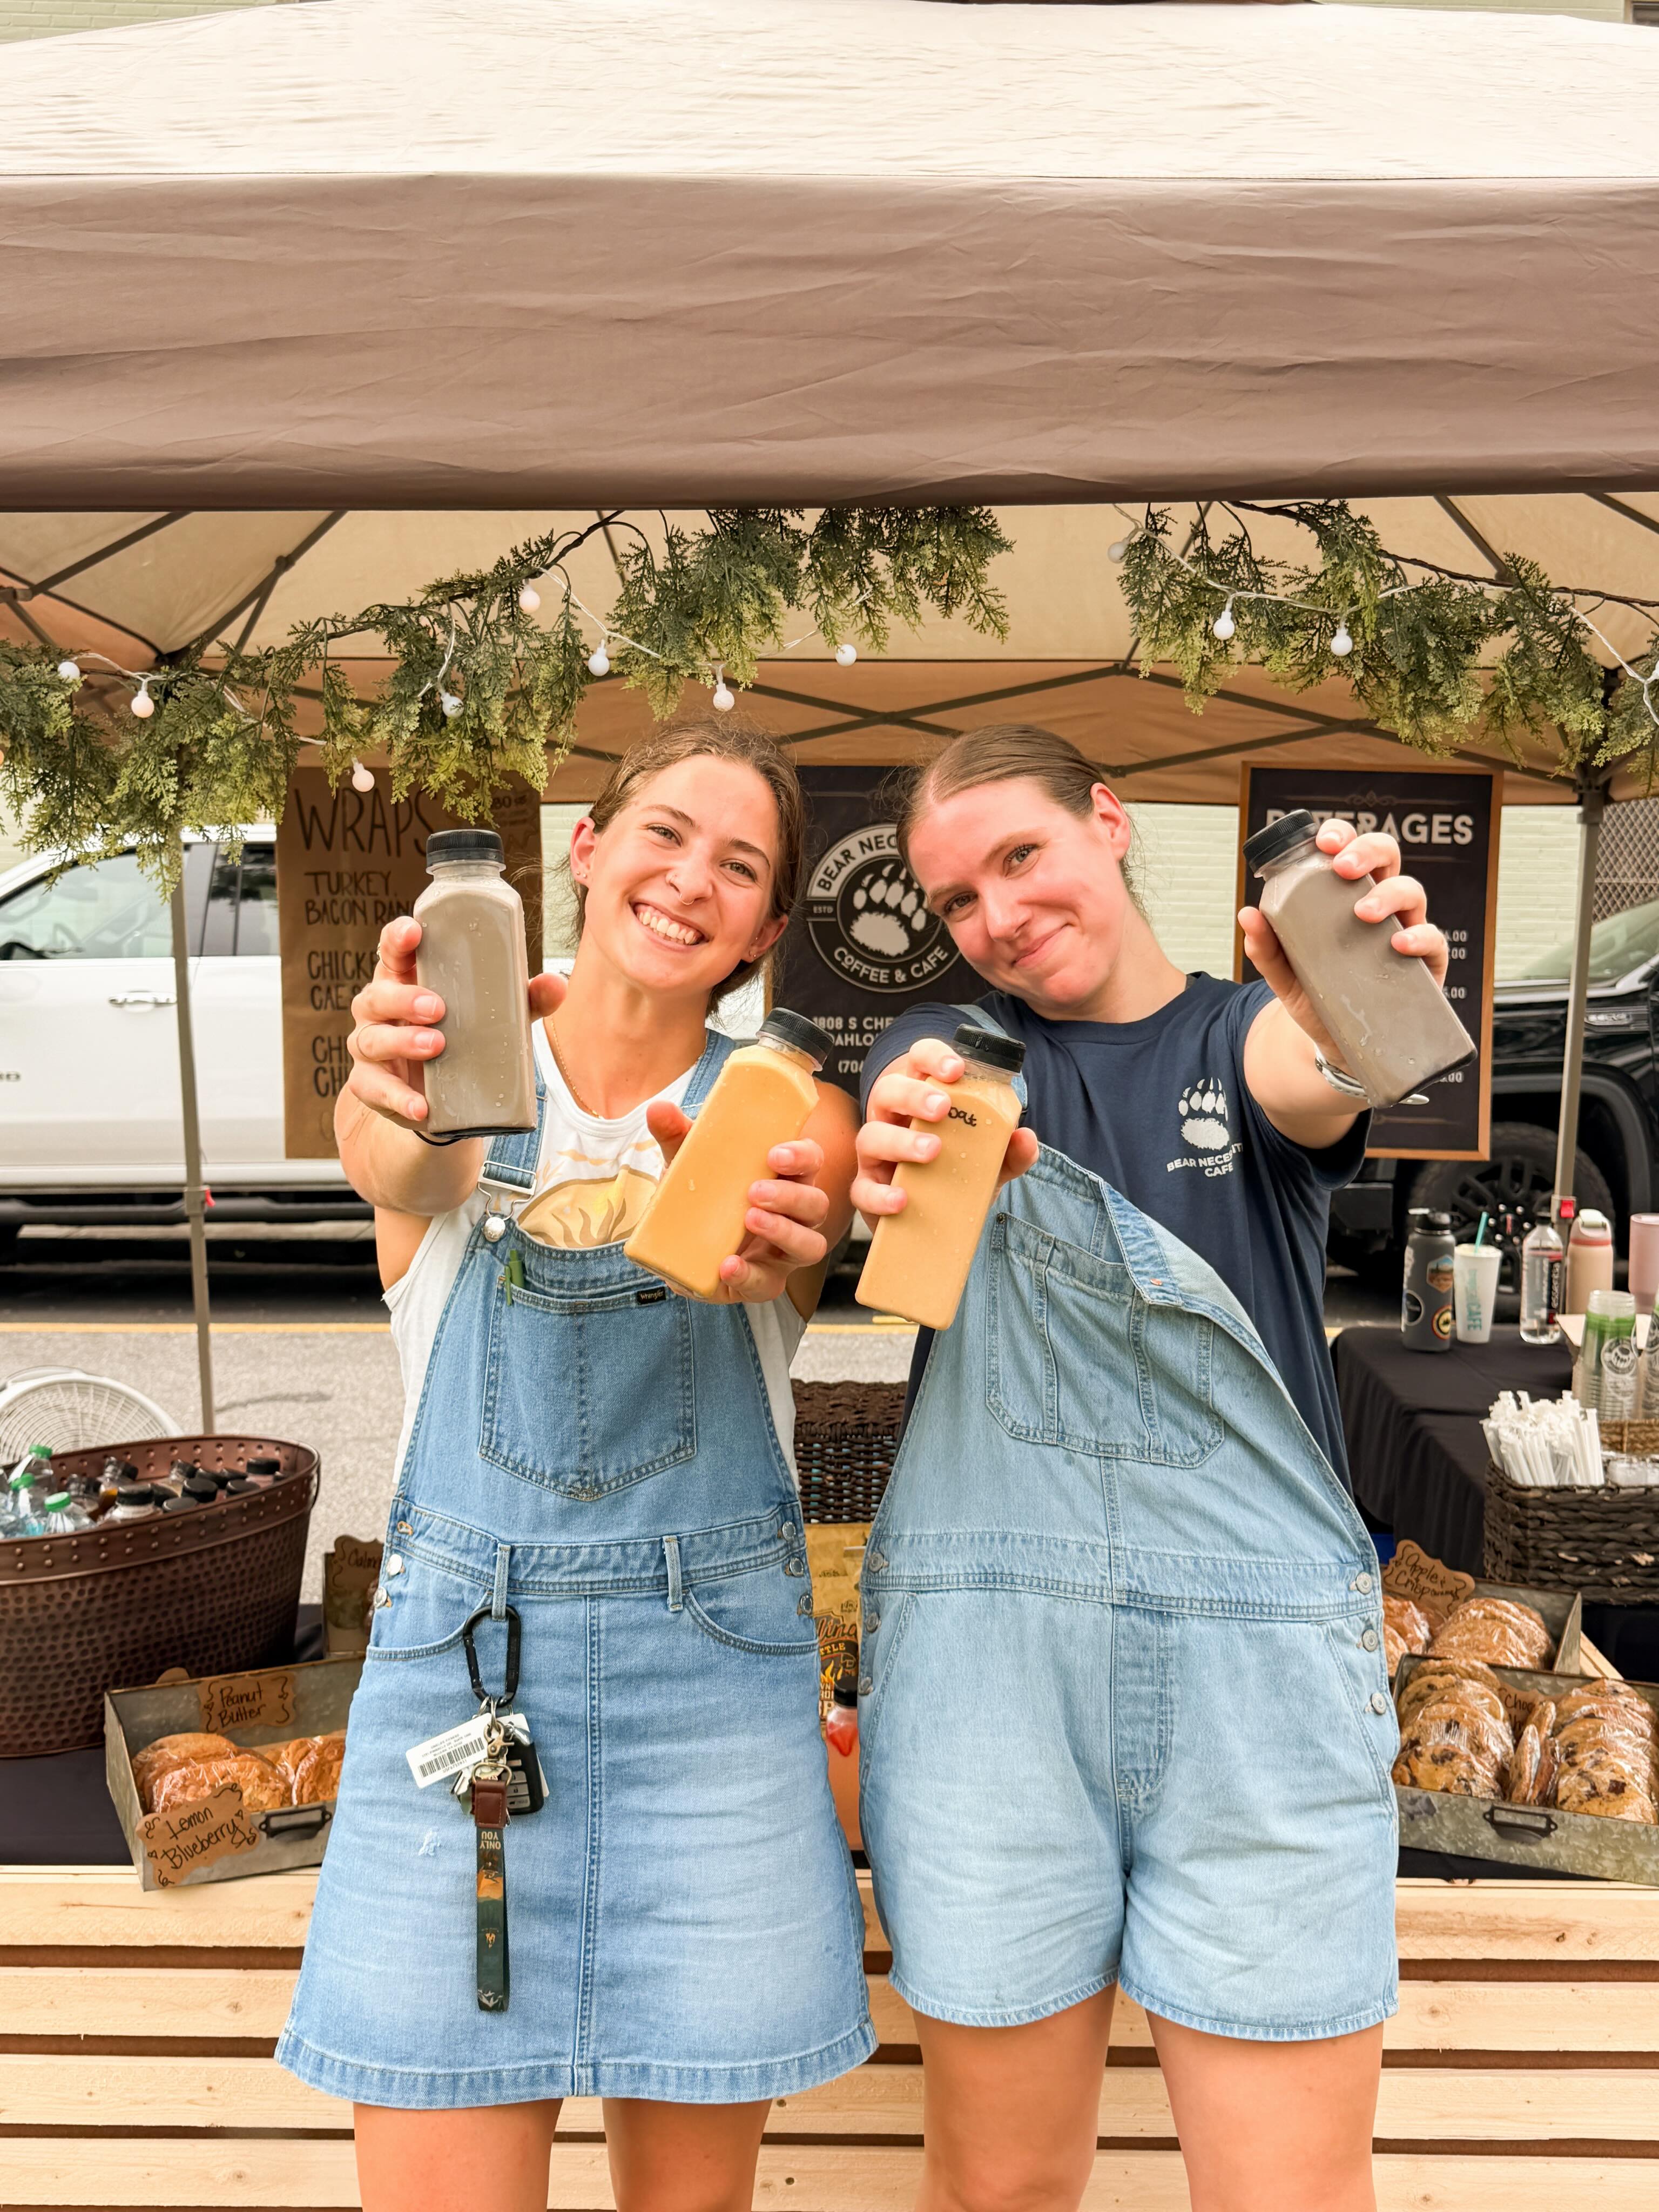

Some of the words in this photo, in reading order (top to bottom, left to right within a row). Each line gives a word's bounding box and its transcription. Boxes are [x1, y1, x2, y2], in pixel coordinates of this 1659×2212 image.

[295, 787, 437, 858] WRAPS
[817, 849, 856, 891] BEAR
[305, 899, 369, 926] BACON
[813, 905, 833, 914] ESTD
[834, 947, 891, 983] COFFEE
[894, 969, 907, 983] &
[911, 946, 949, 978] CAFE
[848, 1016, 858, 1030] S
[1166, 1158, 1197, 1172] BEAR
[1204, 1162, 1233, 1177] CAFE
[220, 1682, 263, 1708] Peanut
[218, 1704, 267, 1728] Butter
[166, 1806, 214, 1840] Lemon
[481, 1831, 499, 1840] YOU
[160, 1818, 242, 1870] Blueberry
[479, 1840, 502, 1850] ONLY
